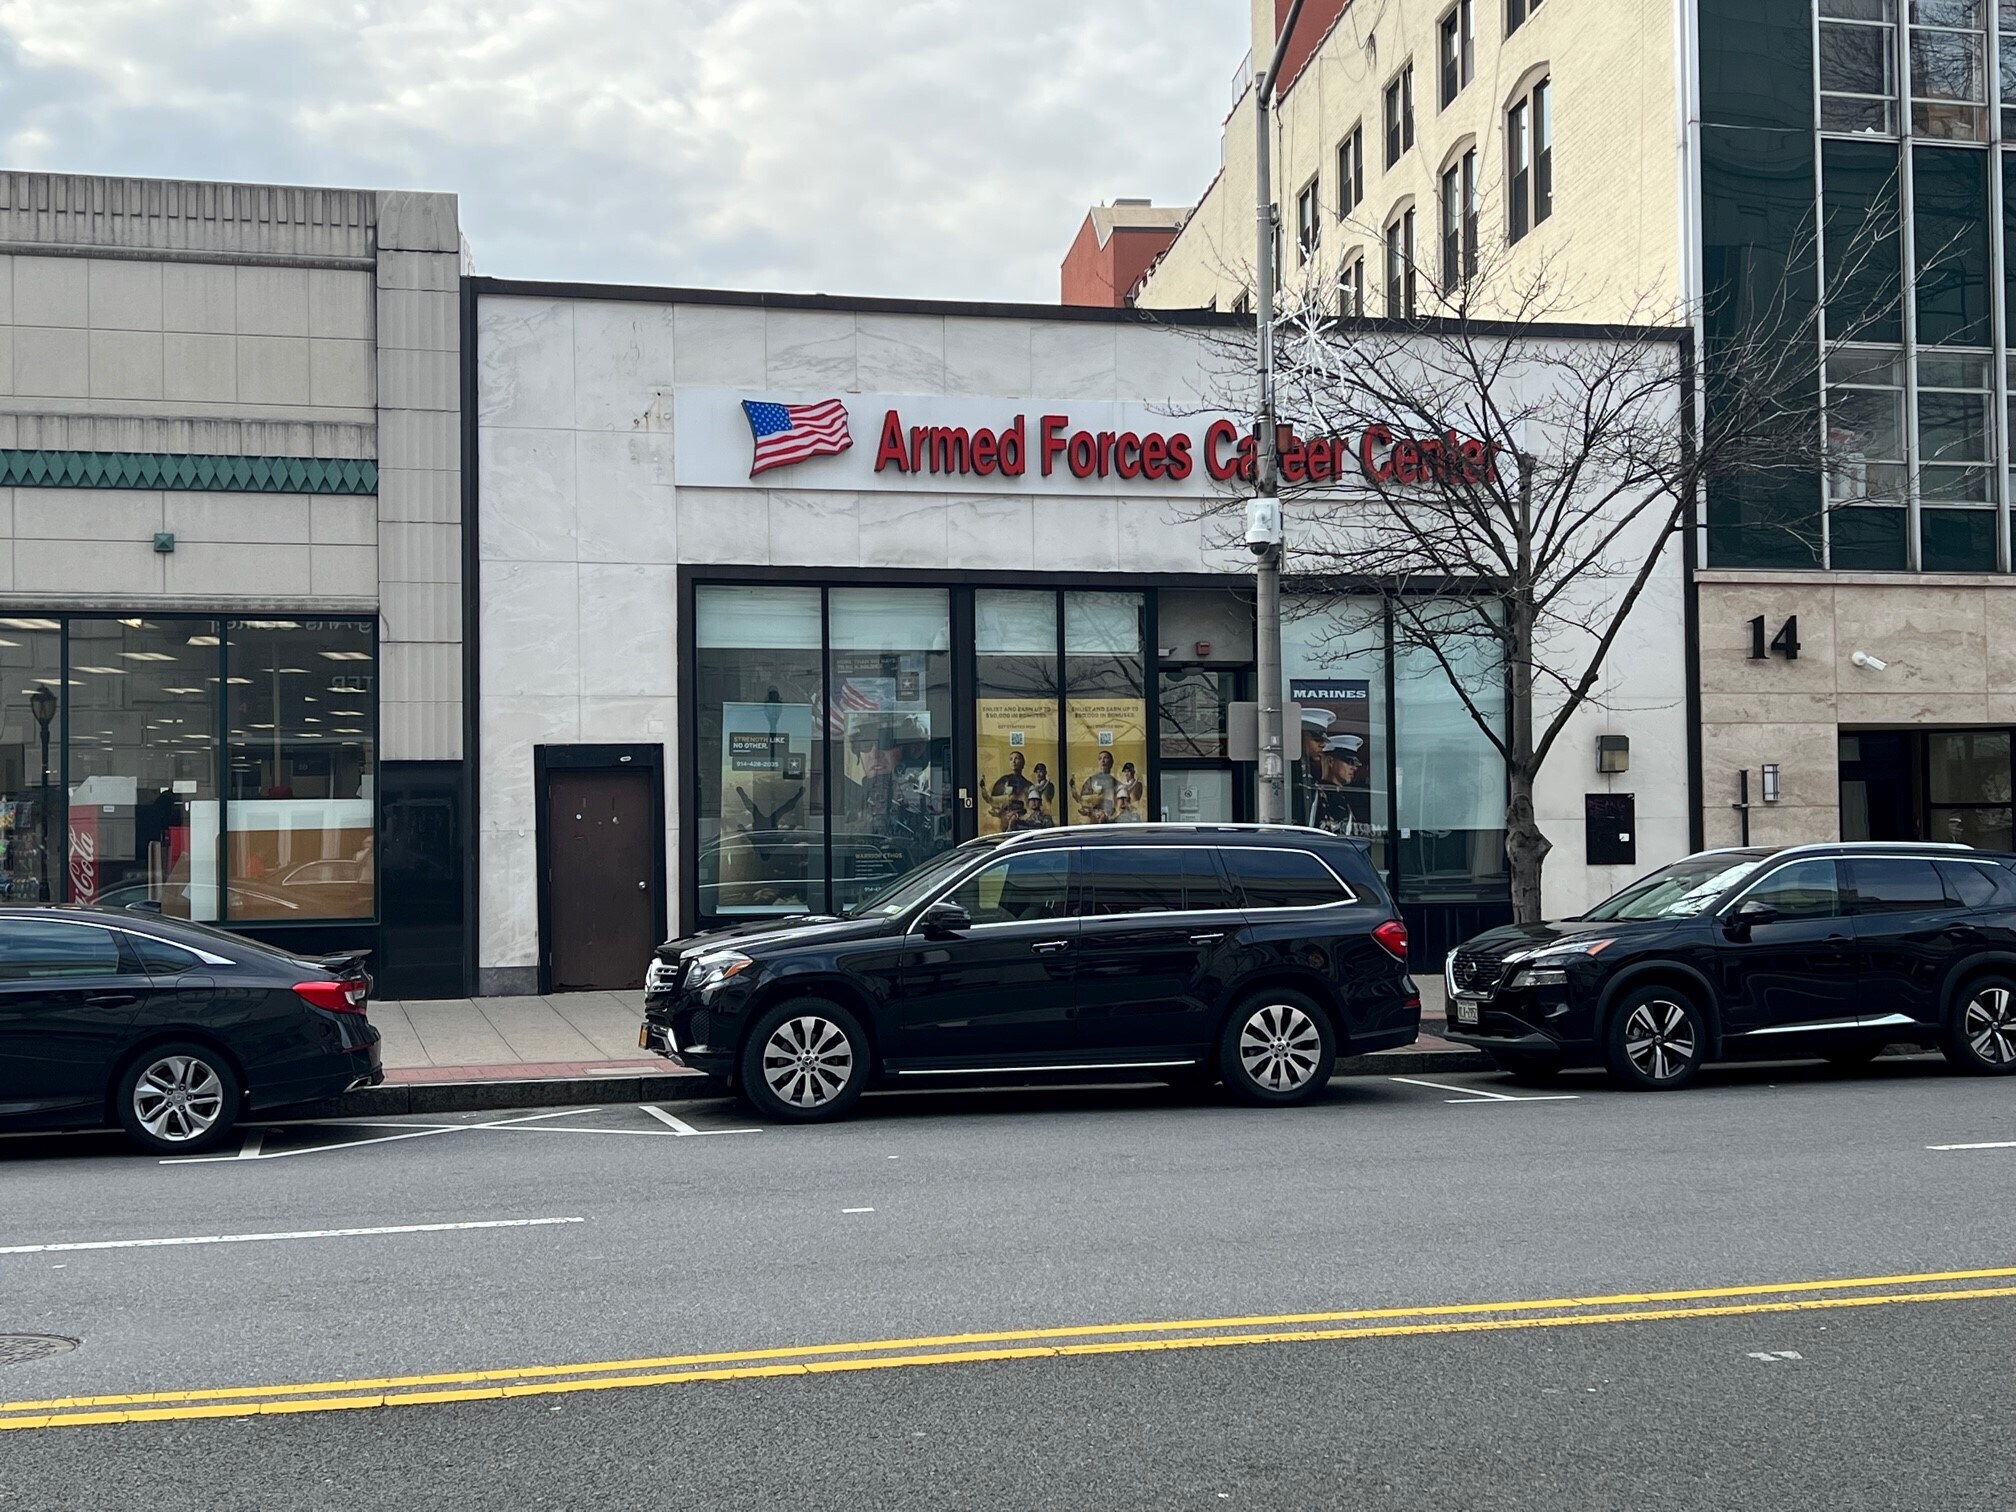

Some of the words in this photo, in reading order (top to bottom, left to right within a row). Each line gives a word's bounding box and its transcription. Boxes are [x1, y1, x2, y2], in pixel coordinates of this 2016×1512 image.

[874, 409, 1025, 478] Armed
[1039, 413, 1192, 481] Forces
[1204, 419, 1348, 482] Caeer
[1359, 423, 1502, 485] Center
[1747, 614, 1801, 660] 14
[1293, 689, 1367, 698] MARINES
